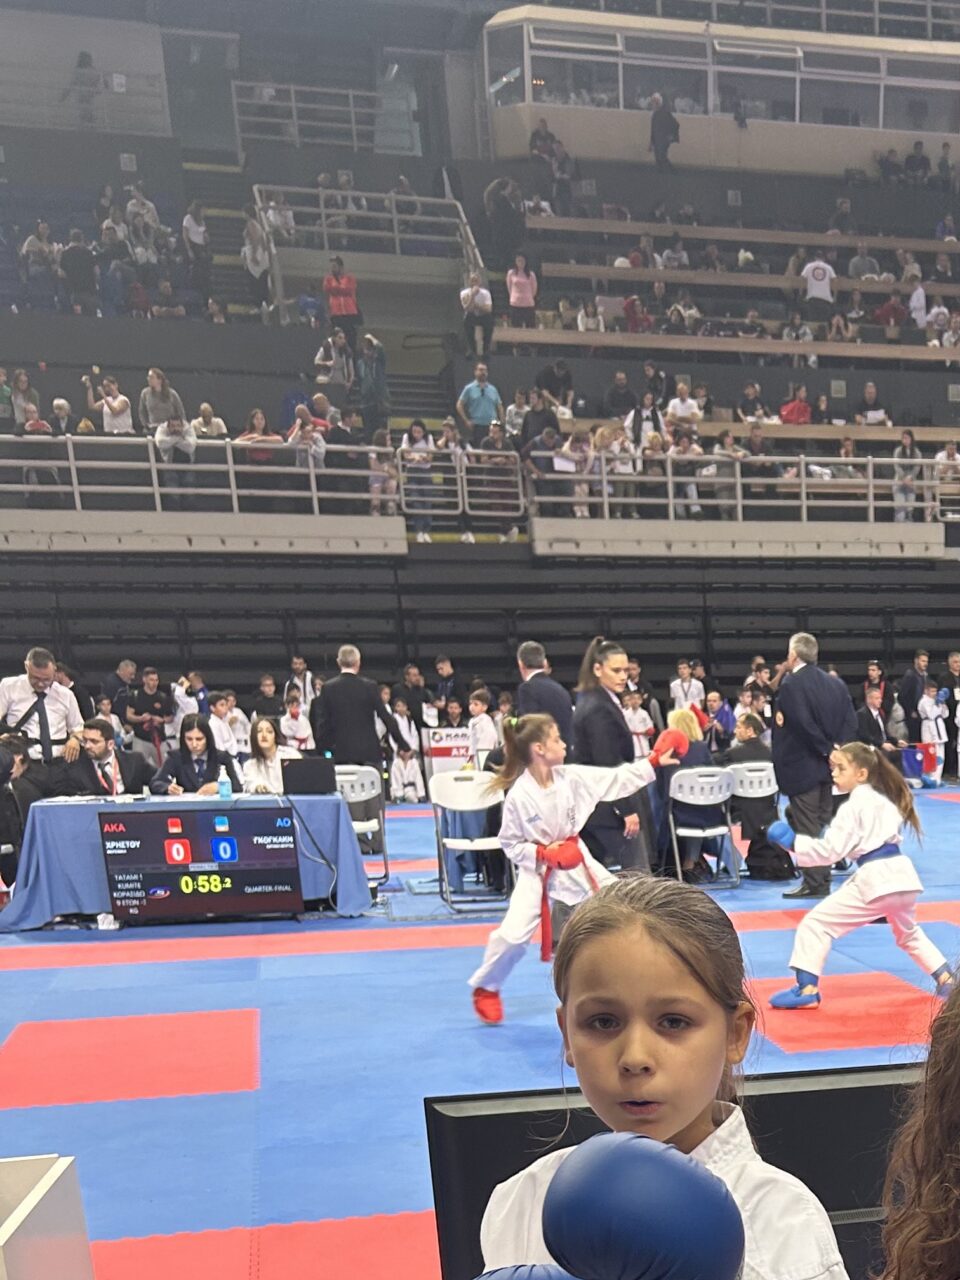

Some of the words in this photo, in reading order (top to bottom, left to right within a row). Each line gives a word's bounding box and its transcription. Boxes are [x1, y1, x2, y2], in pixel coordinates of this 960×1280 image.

[103, 823, 126, 833] AKA
[172, 845, 184, 861] 0
[219, 842, 231, 859] 0
